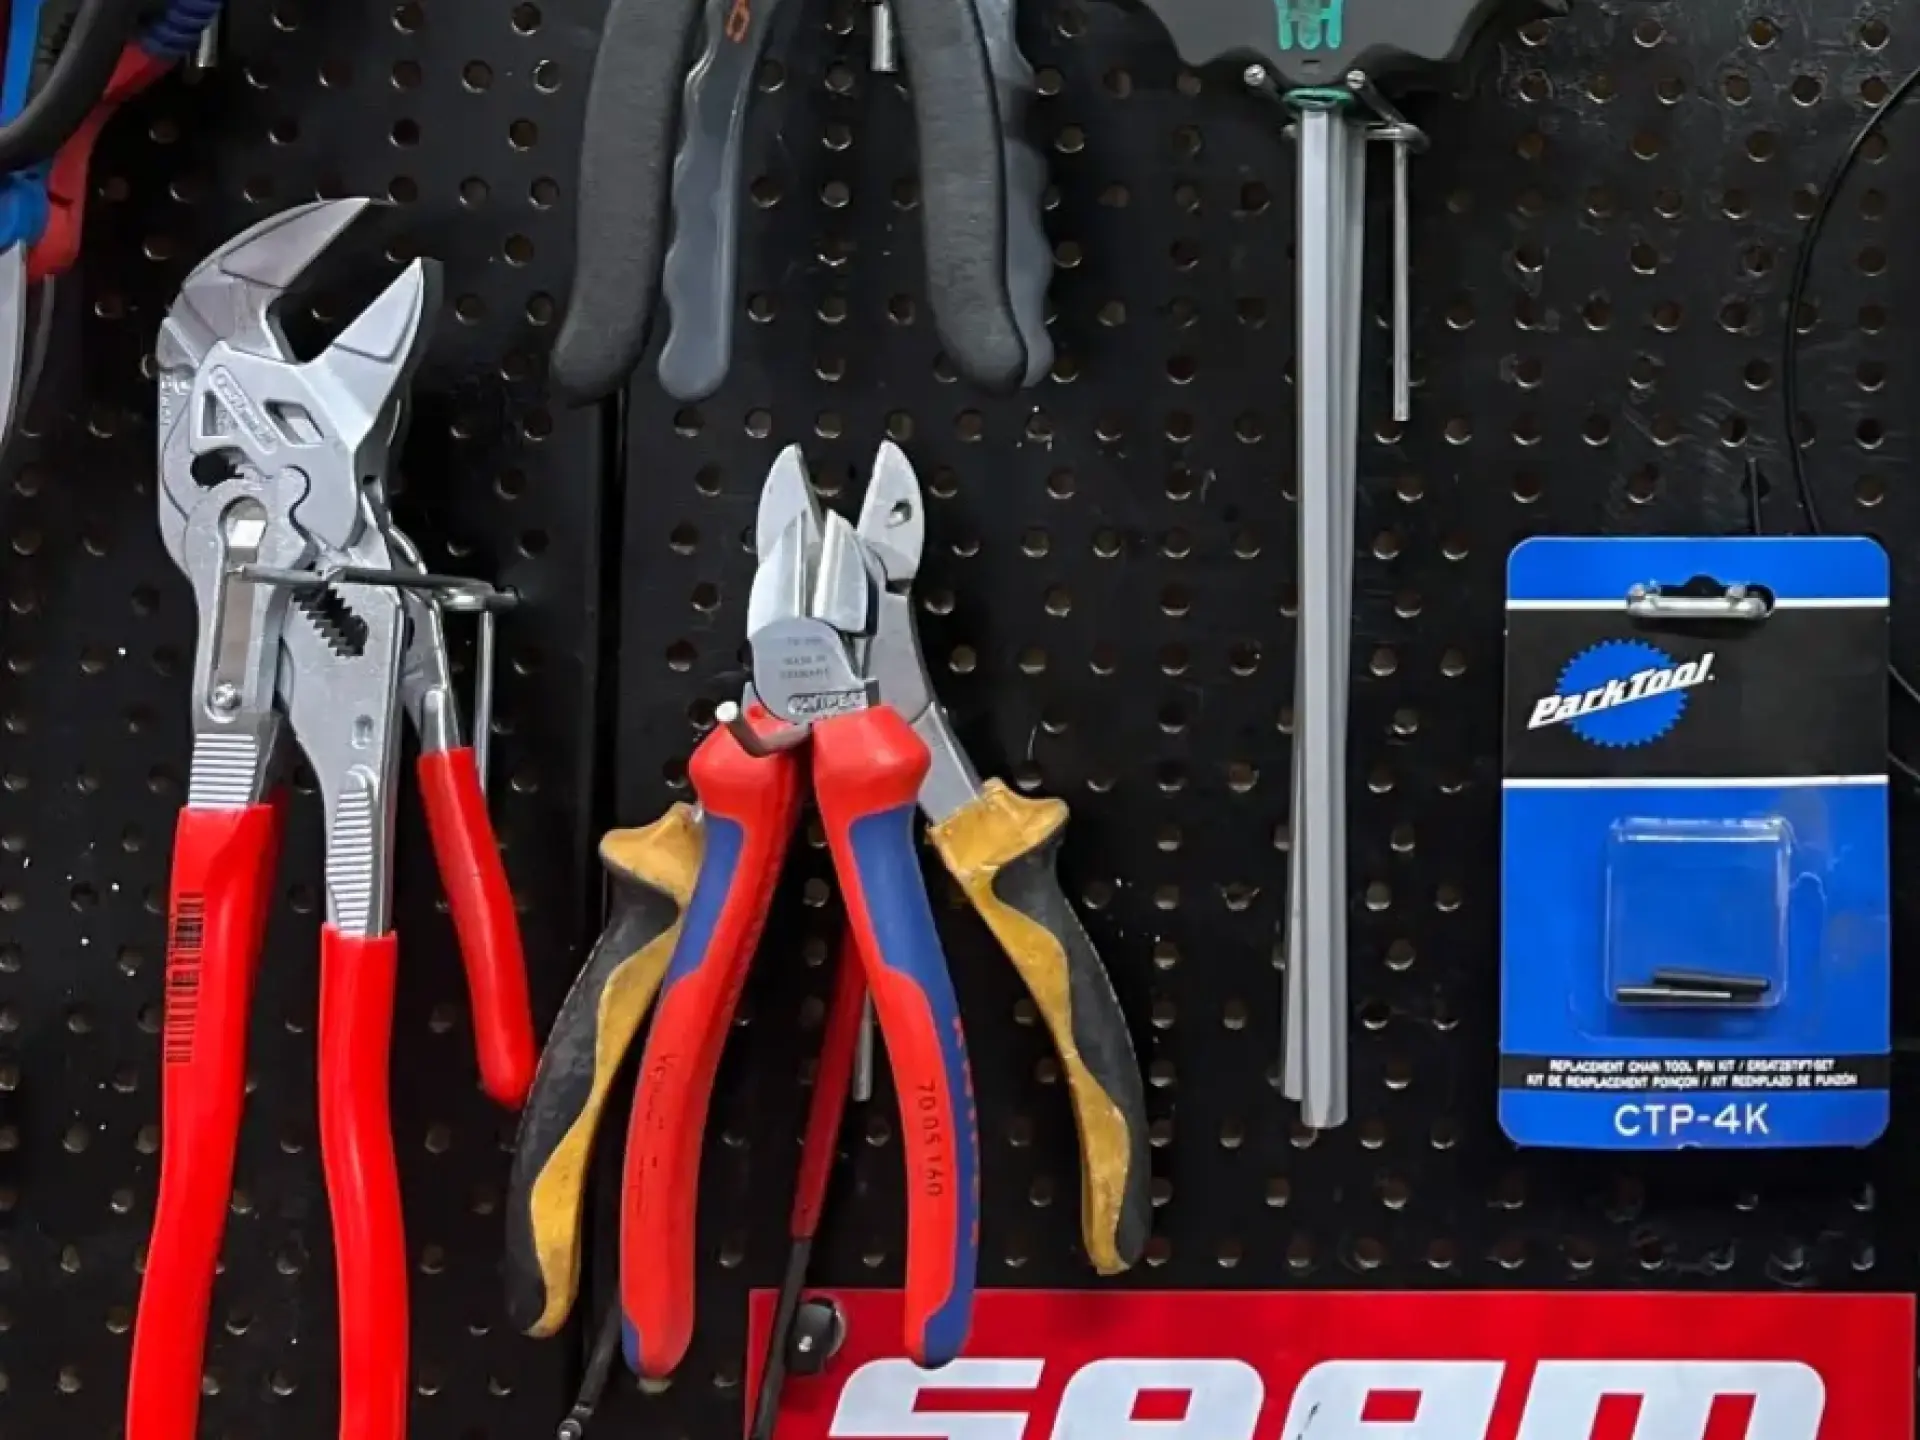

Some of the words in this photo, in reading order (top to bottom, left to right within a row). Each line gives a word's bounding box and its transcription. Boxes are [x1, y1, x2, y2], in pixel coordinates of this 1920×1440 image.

[1549, 1059, 1625, 1073] REPLACEMENT
[1627, 1059, 1662, 1073] CHAIN
[1663, 1059, 1693, 1073] TOOL
[1696, 1059, 1716, 1072] PIN
[1718, 1059, 1736, 1072] KIT
[1526, 1074, 1544, 1087] KIT
[1547, 1074, 1562, 1087] DE
[1565, 1074, 1649, 1088] REMPLACEMENT
[1710, 1074, 1728, 1087] KIT
[1796, 1074, 1811, 1087] DE
[1614, 1102, 1770, 1137] CTP-4K
